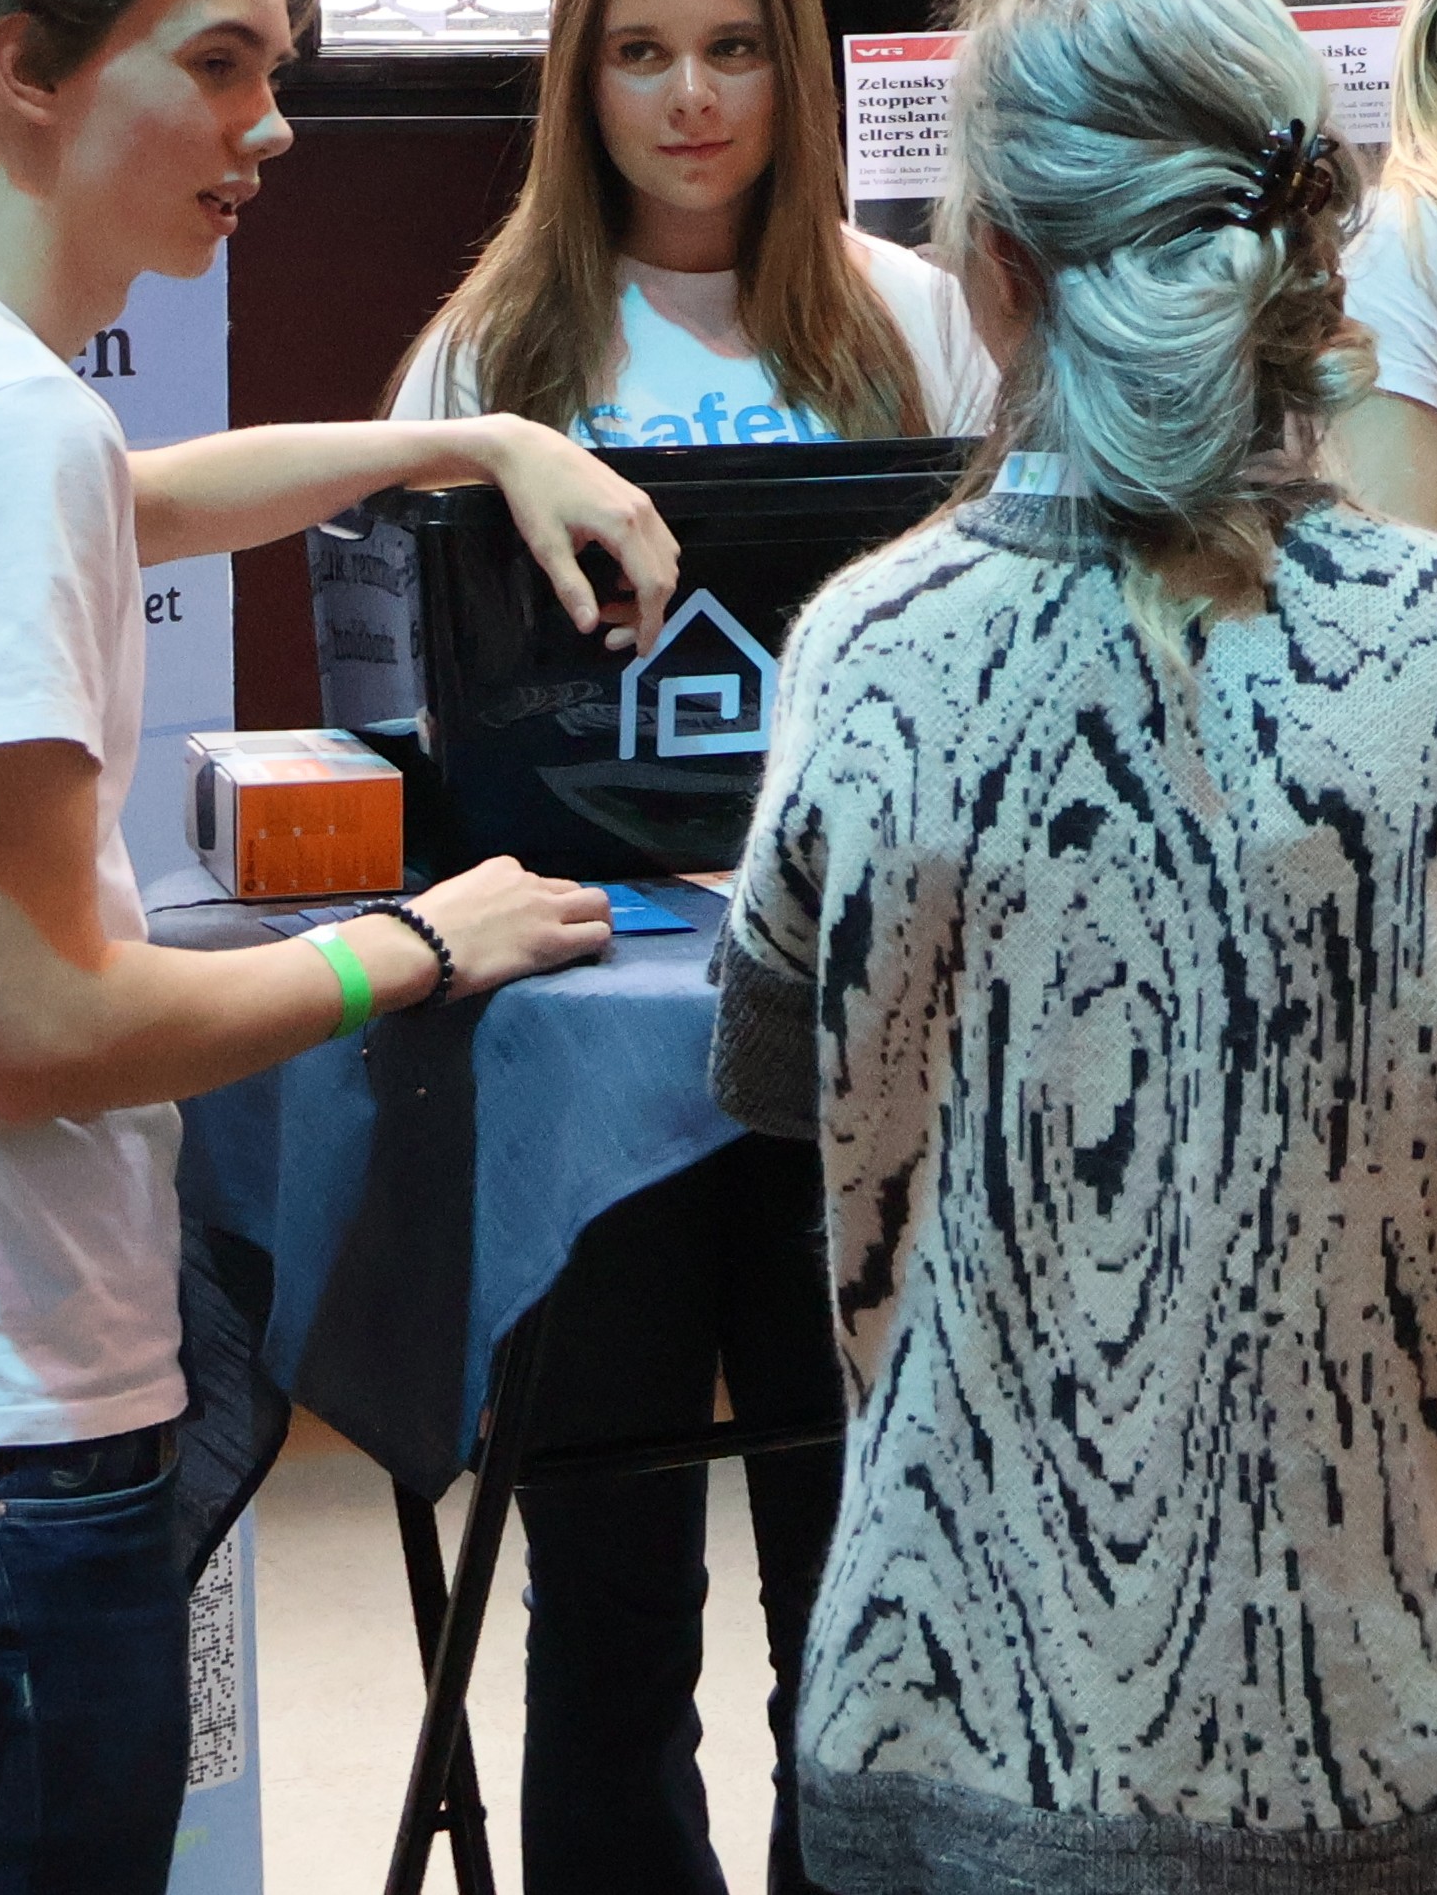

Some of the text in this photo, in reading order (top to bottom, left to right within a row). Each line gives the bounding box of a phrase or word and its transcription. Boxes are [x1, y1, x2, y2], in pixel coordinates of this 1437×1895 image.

[856, 47, 904, 57] VG
[857, 95, 937, 110] stopper
[858, 128, 916, 142] ellers
[859, 144, 931, 159] verden
